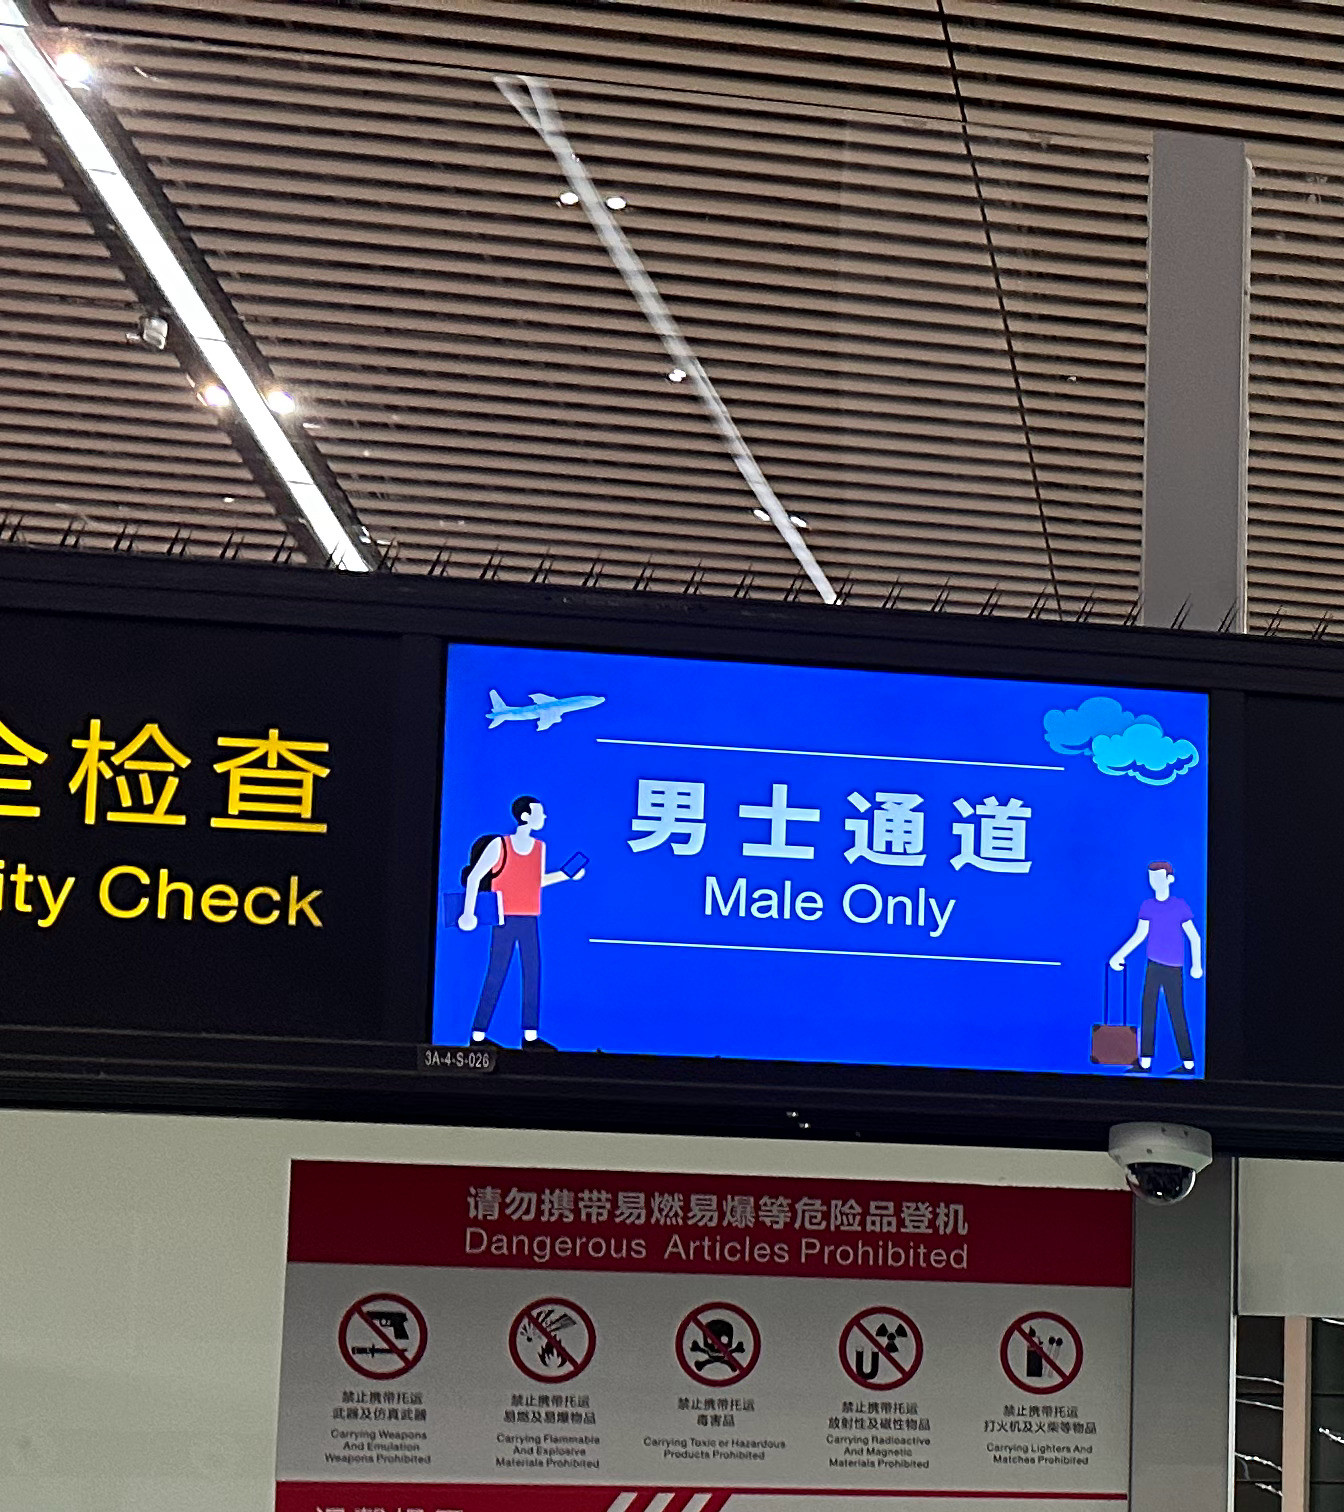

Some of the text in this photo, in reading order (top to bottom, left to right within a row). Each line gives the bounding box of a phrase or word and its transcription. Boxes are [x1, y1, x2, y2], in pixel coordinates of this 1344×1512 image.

[627, 779, 1032, 873] 男士通道
[99, 865, 323, 928] Check
[705, 876, 956, 938] Male Only
[467, 1186, 969, 1236] 请勿携带易燃易爆等危险品登机
[465, 1227, 969, 1269] Dangerous Articles Prohibited
